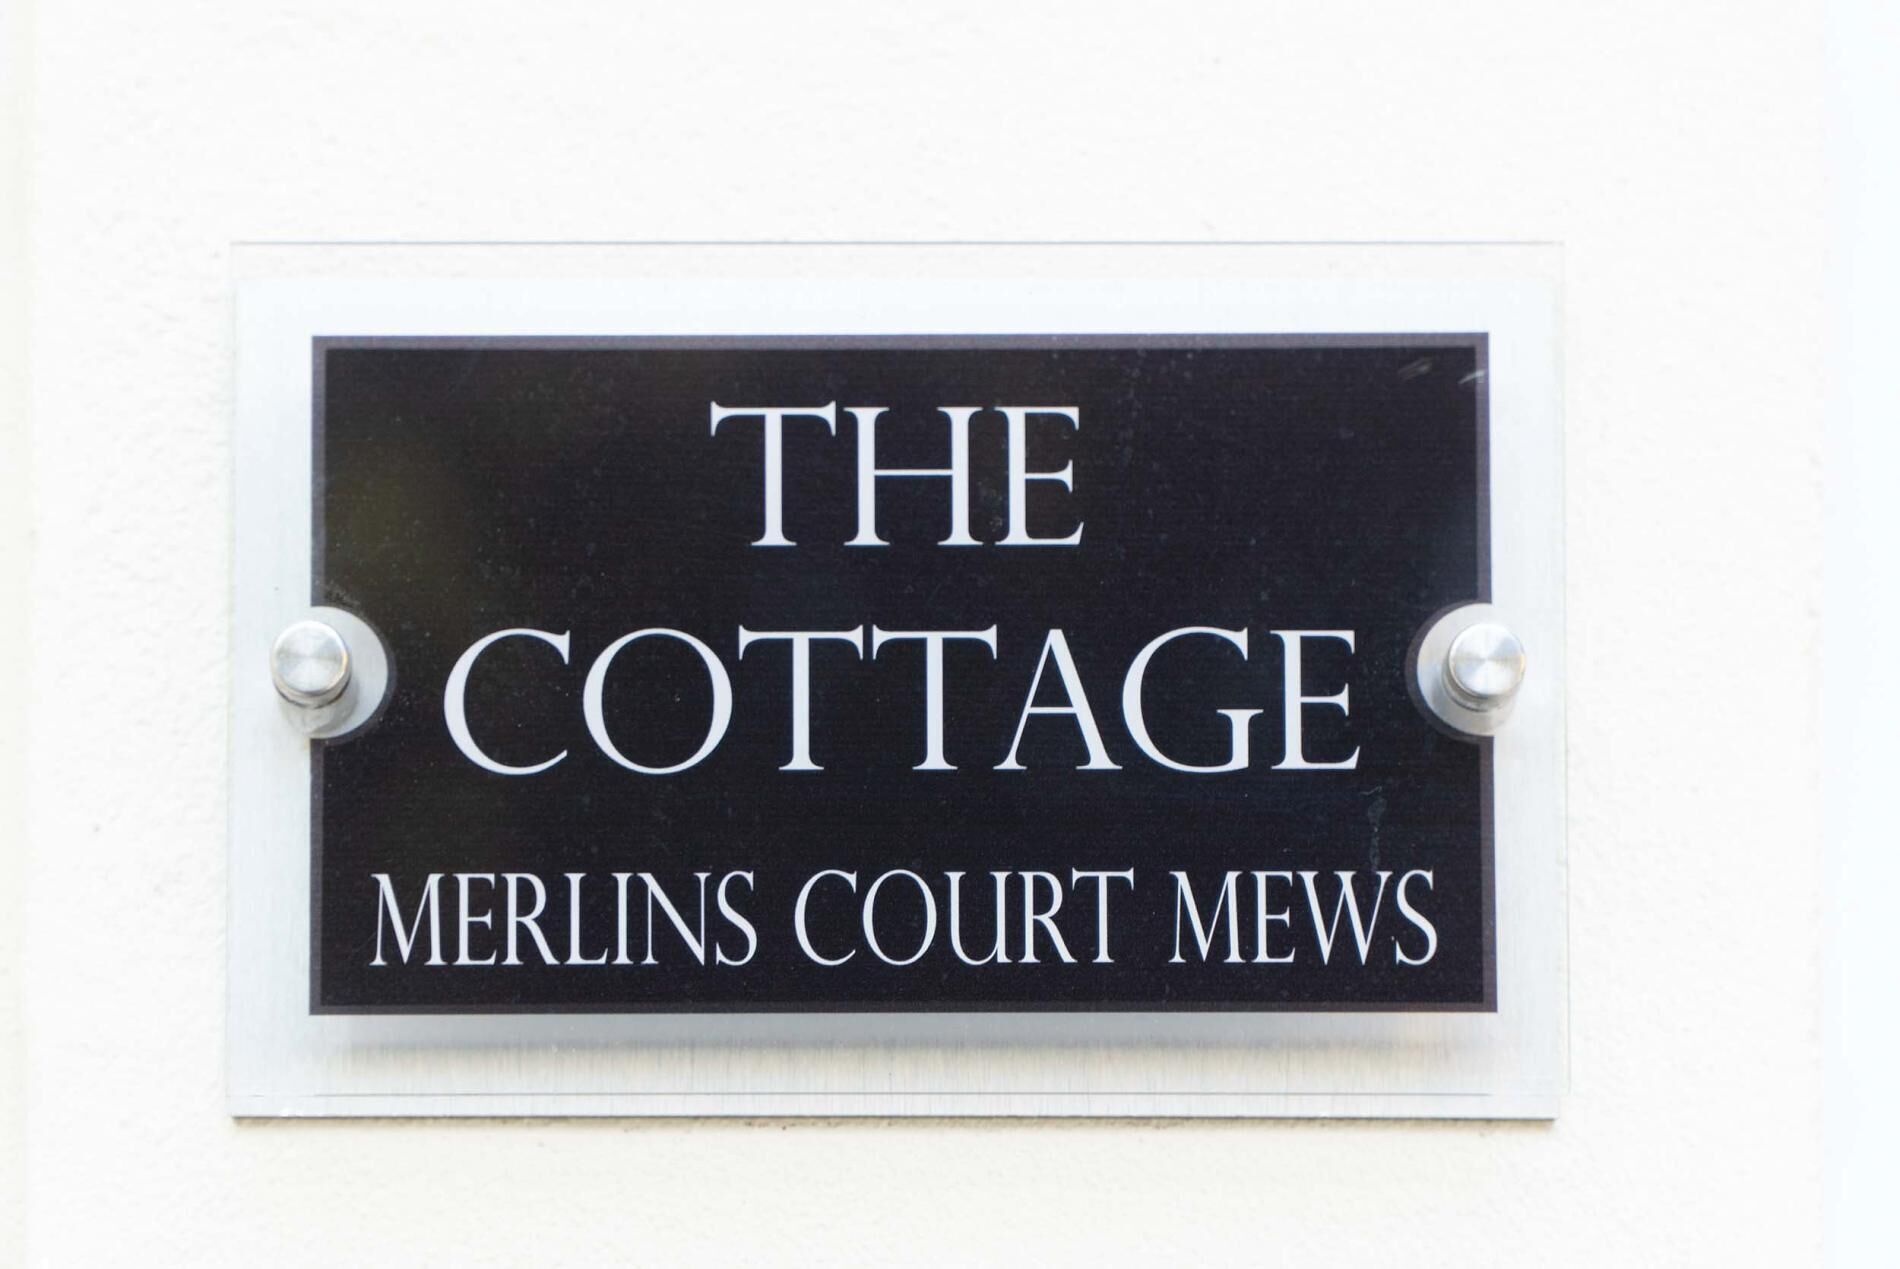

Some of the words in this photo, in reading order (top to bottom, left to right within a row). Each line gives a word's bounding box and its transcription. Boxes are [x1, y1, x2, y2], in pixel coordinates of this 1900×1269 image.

[710, 400, 1084, 547] THE
[443, 624, 1361, 775] COTTAGE
[369, 869, 758, 967] MERLINS
[794, 867, 1136, 967] COURT
[1168, 868, 1438, 967] MEWS
